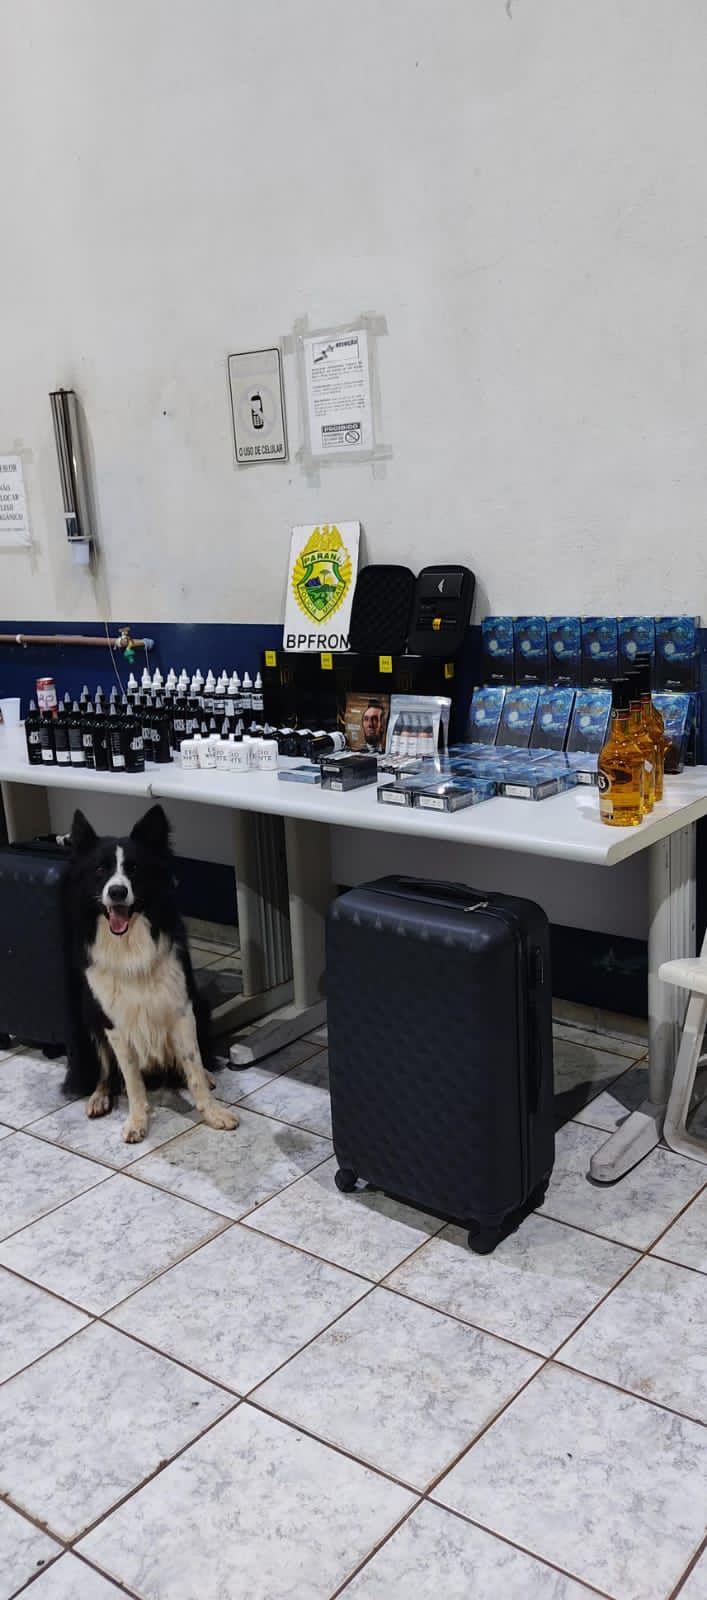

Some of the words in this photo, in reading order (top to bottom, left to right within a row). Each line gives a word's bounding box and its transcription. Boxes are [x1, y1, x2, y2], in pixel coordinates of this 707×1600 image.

[244, 447, 254, 456] USO
[254, 446, 262, 455] DE
[261, 443, 283, 454] CELULAR
[286, 633, 349, 649] BPFRON
